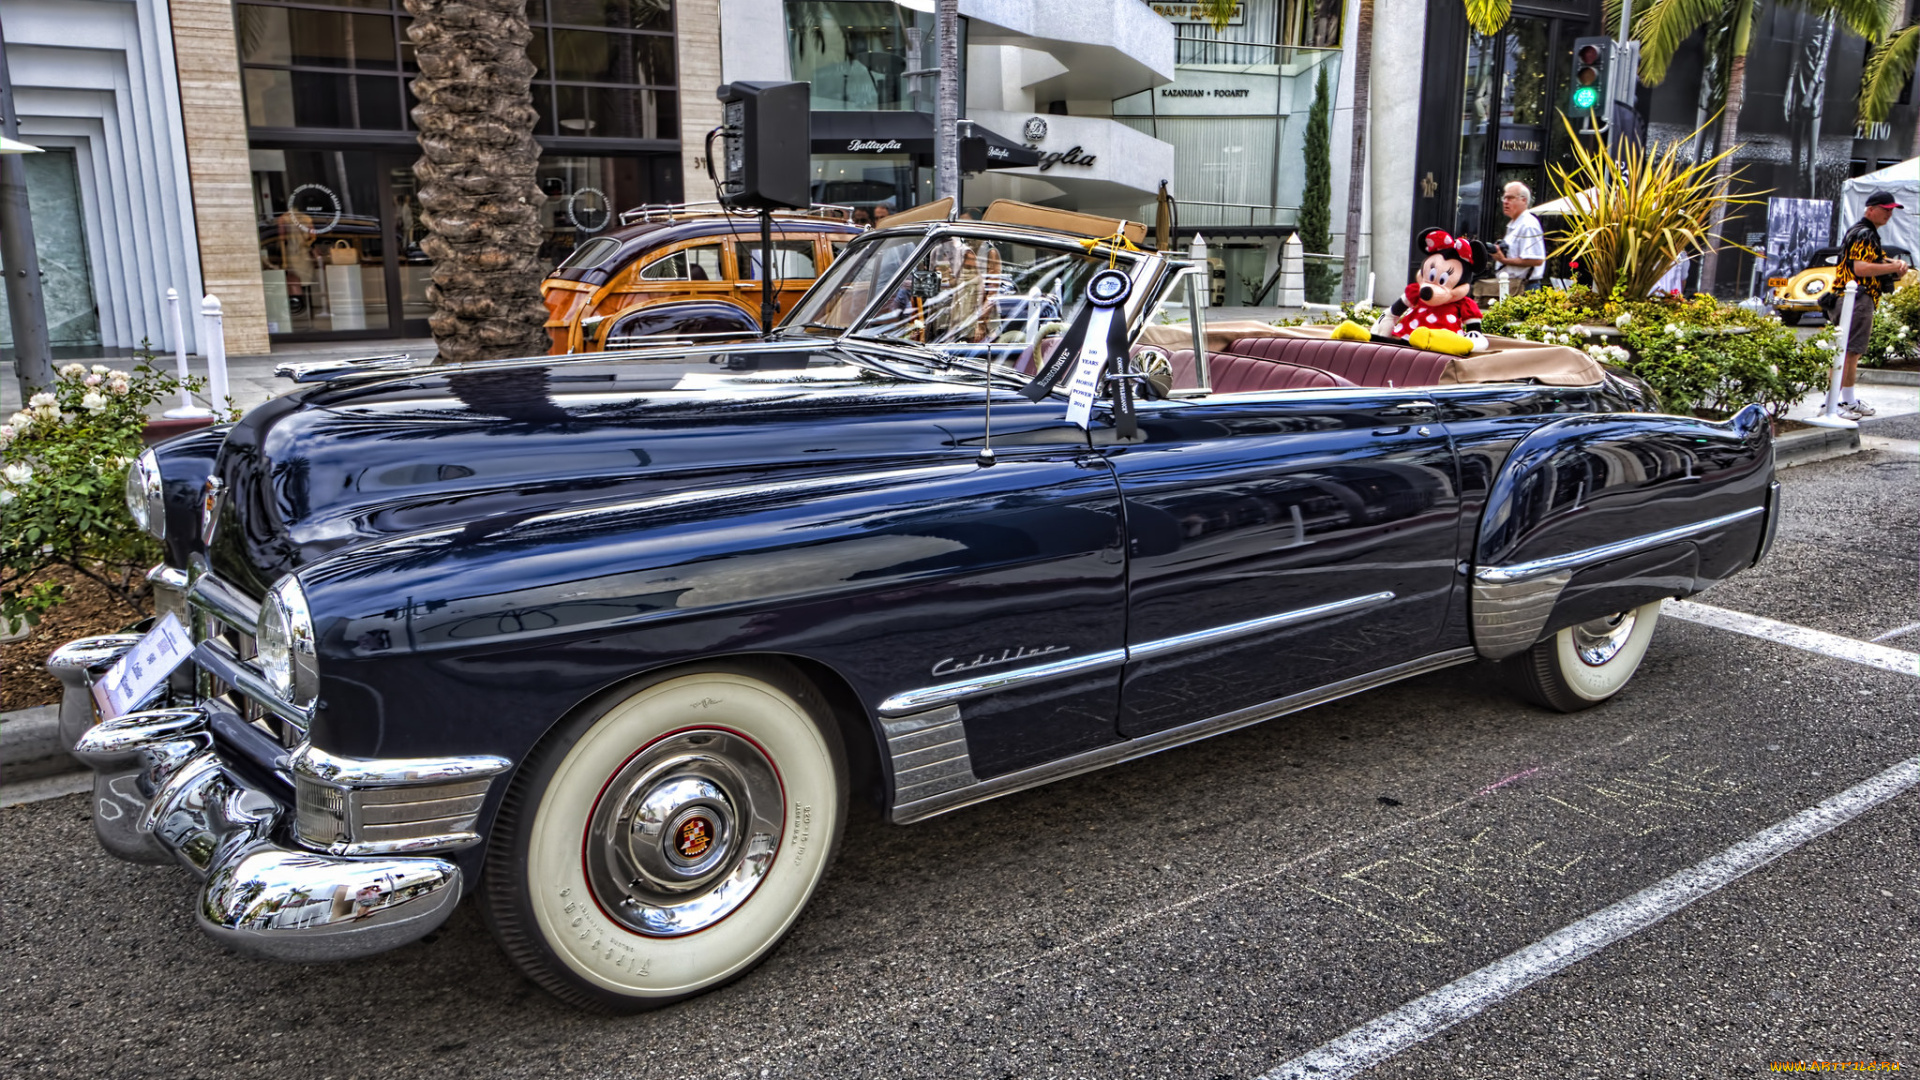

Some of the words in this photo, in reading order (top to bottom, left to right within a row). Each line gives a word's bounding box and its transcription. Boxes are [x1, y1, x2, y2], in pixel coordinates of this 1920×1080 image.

[1162, 89, 1204, 98] KAZANJIAN
[1214, 89, 1250, 98] FOGARTY
[847, 139, 902, 154] Battaglia
[1082, 358, 1099, 366] YEARS
[1076, 379, 1094, 387] HORSE
[1073, 389, 1092, 398] POWER
[932, 645, 1071, 677] Cadillac
